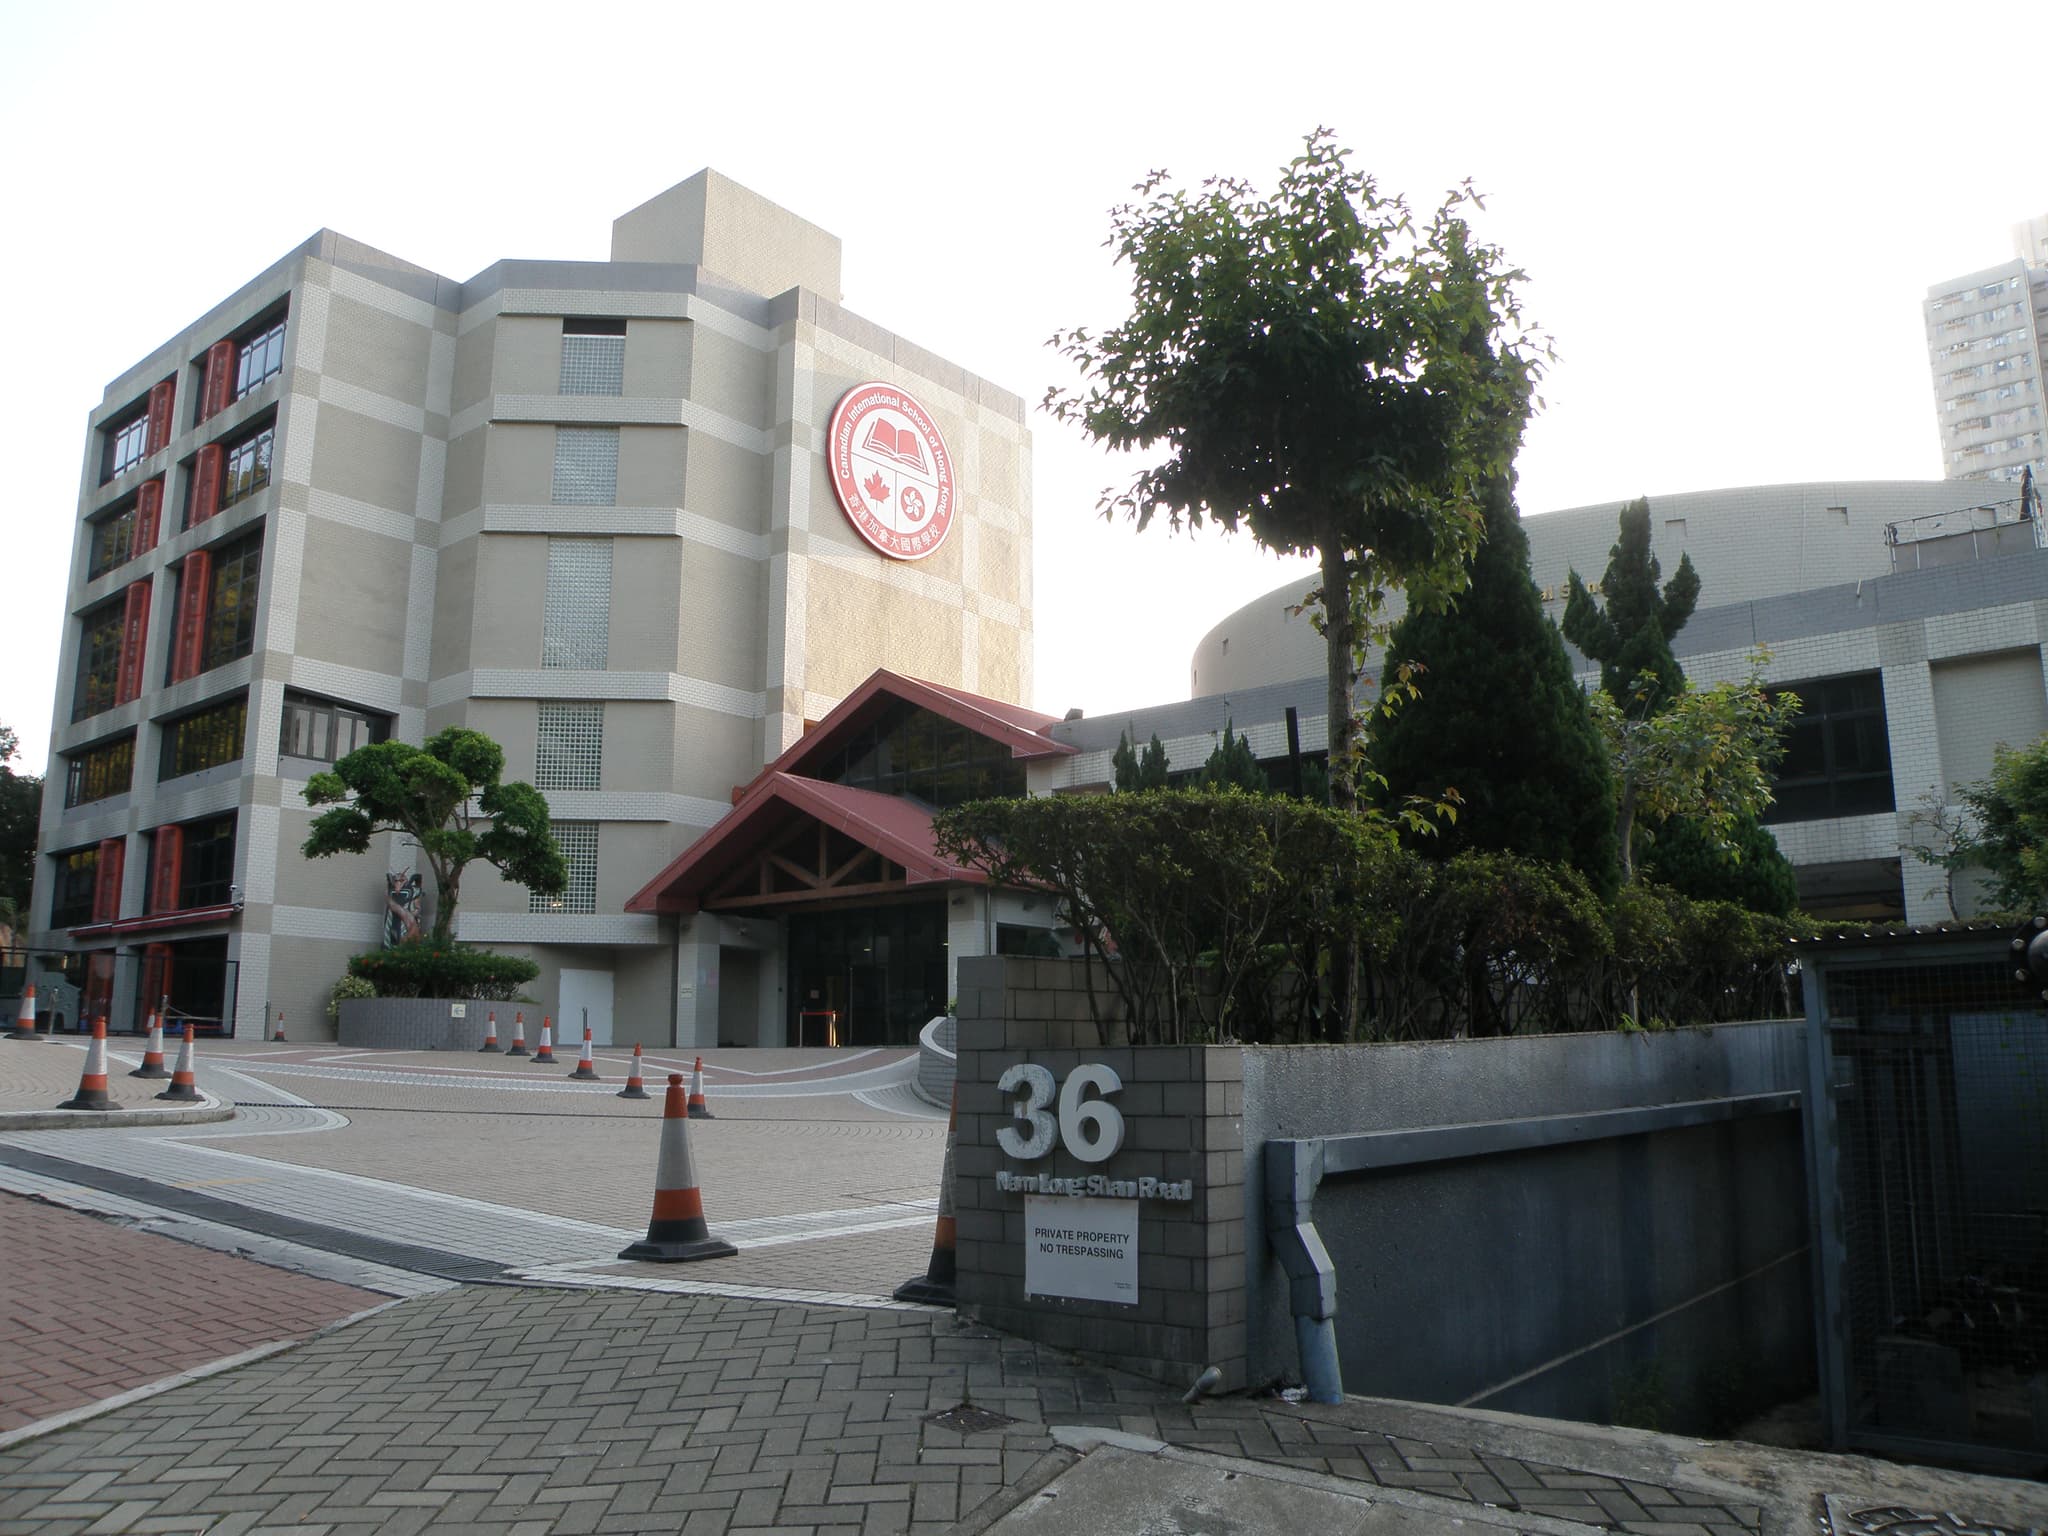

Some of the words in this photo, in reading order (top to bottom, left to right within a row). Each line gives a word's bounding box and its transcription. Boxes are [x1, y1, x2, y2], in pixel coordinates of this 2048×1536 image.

[848, 393, 900, 422] International
[902, 401, 931, 434] School
[840, 421, 853, 479] Canadian
[929, 434, 938, 449] of
[935, 448, 949, 484] Hong
[937, 485, 950, 518] Kong
[996, 1063, 1125, 1162] 36
[996, 1171, 1038, 1195] Nam
[1039, 1173, 1087, 1198] Long
[1087, 1175, 1138, 1198] Shan
[1138, 1177, 1193, 1200] Road
[1035, 1228, 1074, 1240] PRIVATE
[1076, 1230, 1130, 1244] PROPERTY
[1039, 1243, 1054, 1254] NO
[1056, 1244, 1124, 1260] TRESPASSING
